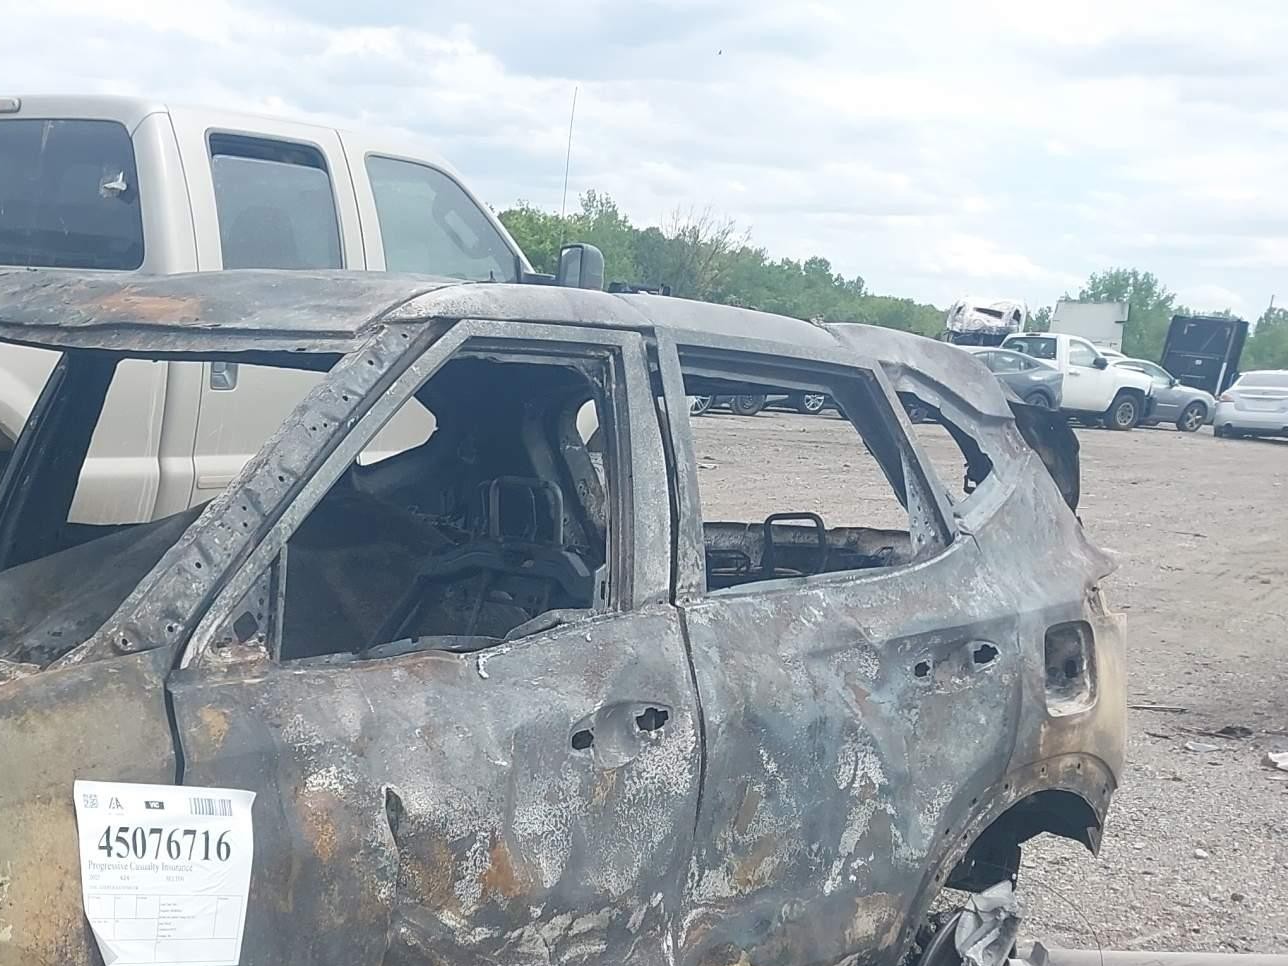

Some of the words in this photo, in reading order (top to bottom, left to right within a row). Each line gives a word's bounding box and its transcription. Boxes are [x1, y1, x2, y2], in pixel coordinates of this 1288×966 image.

[98, 825, 231, 861] 45076716
[88, 860, 128, 872] Progressive
[129, 861, 159, 873] Casualty
[161, 862, 193, 872] Insurance
